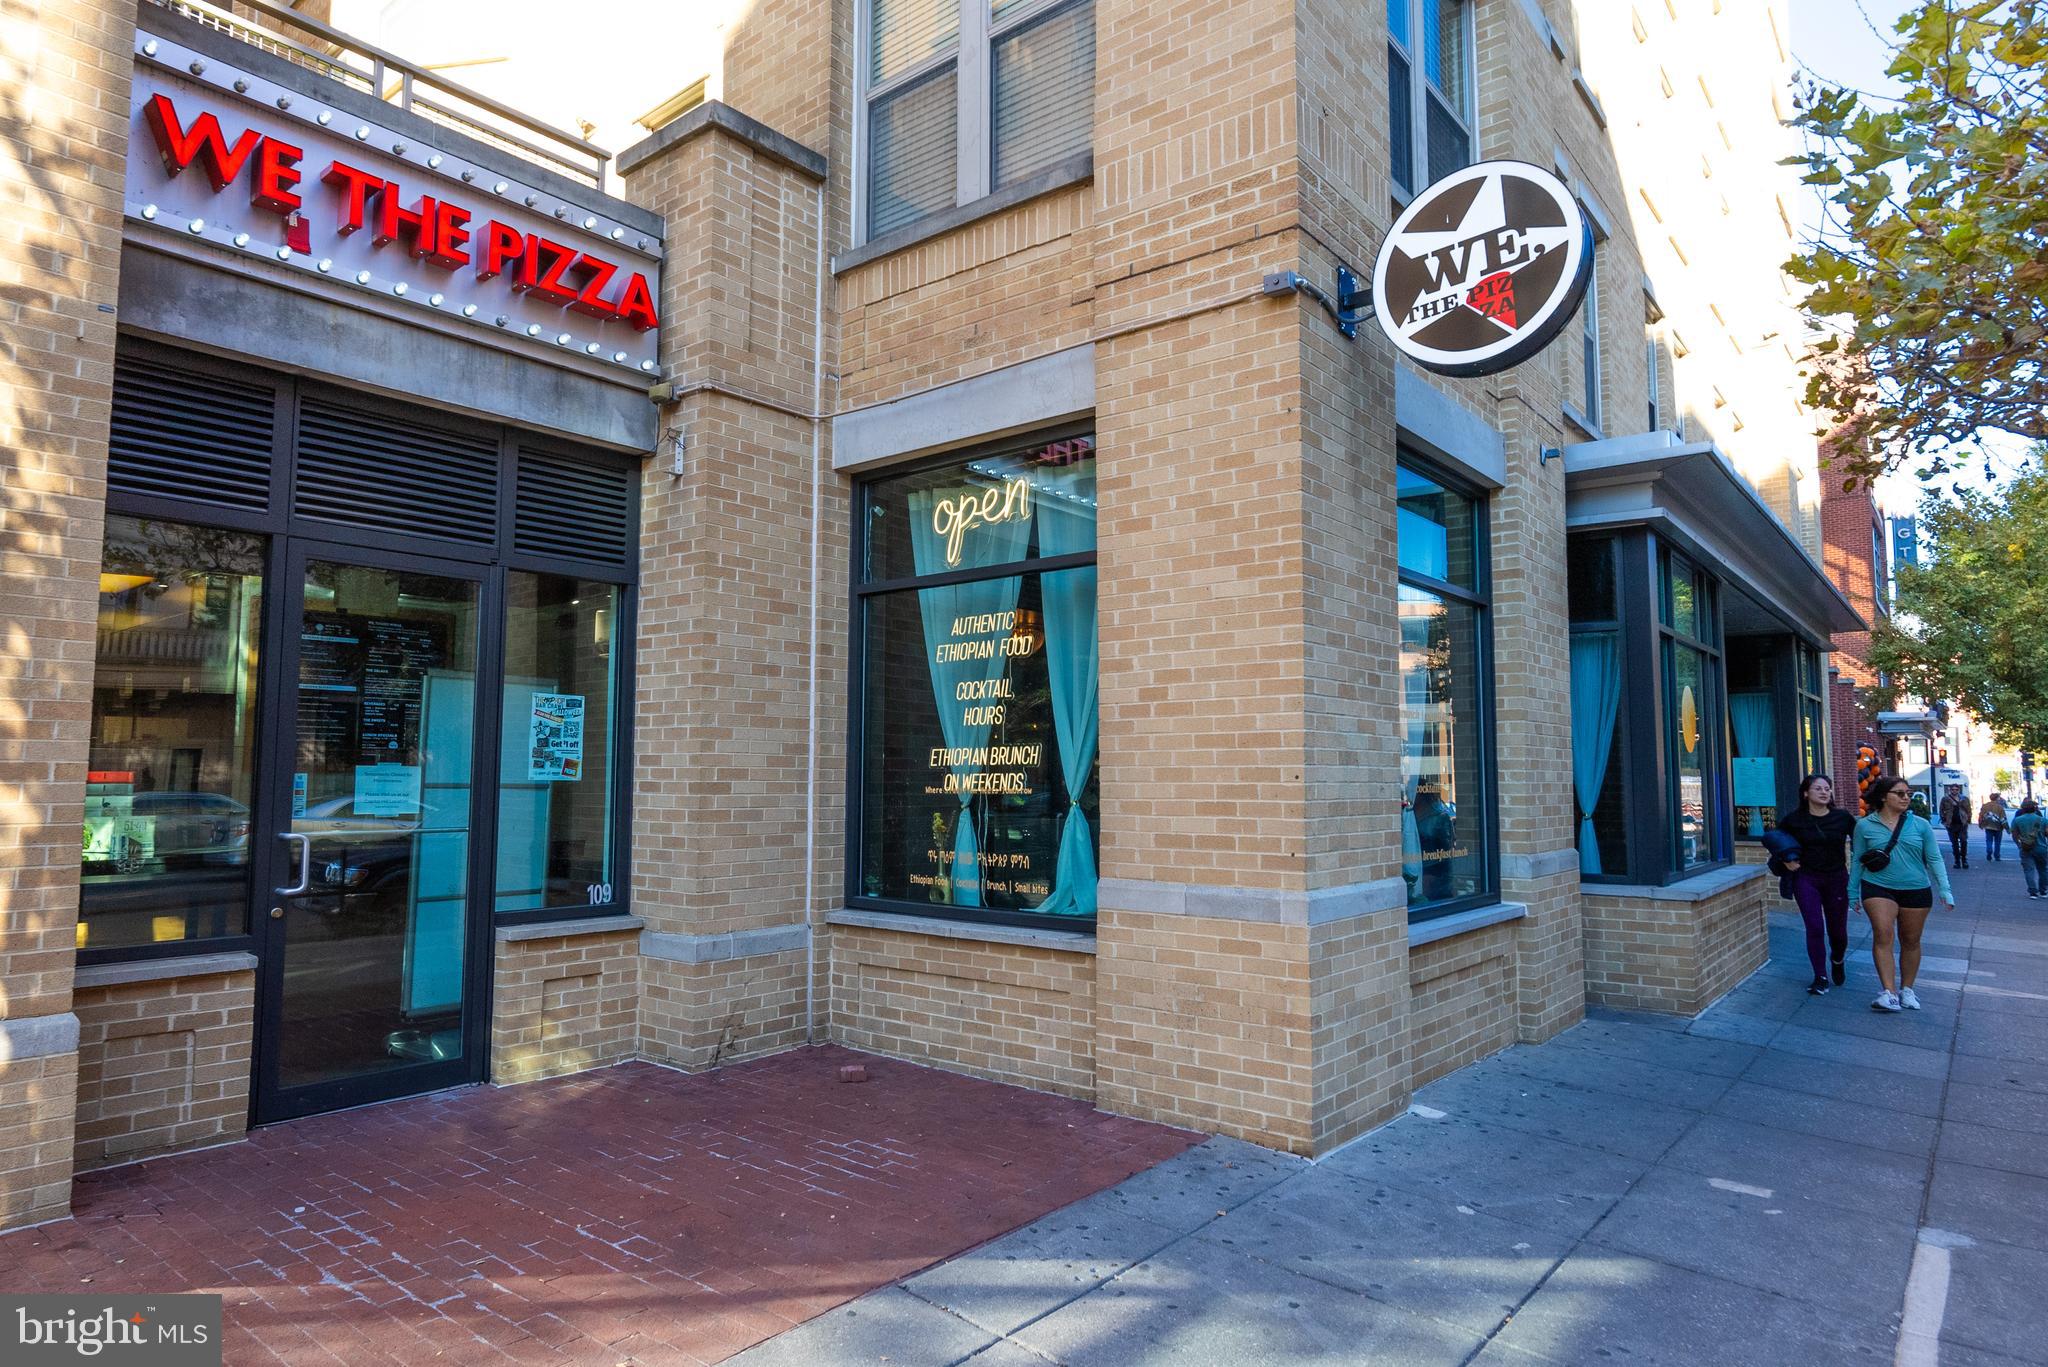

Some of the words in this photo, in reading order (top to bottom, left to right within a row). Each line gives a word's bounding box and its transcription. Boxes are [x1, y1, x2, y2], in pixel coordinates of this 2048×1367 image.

[321, 160, 471, 271] THE
[476, 219, 660, 333] PIZZA
[1407, 293, 1459, 325] THE
[1467, 275, 1514, 304] PIZ
[1479, 296, 1516, 319] ZA
[933, 478, 1029, 564] open
[951, 611, 1016, 637] AUTHENTIC
[936, 639, 995, 664] ETHIOPIAN
[999, 635, 1034, 657] FOOD
[956, 679, 1013, 701] COCKTAIL
[963, 706, 1005, 726] HOURS
[929, 748, 988, 767] ETHIOPIAN
[989, 745, 1041, 766] BRUNCH
[944, 773, 959, 792] ON
[962, 772, 1025, 792] WEEKENDS
[587, 883, 612, 905] 109
[910, 873, 934, 887] Ethiopian
[986, 879, 1007, 891] Brunch
[1014, 882, 1031, 894] Small
[1032, 883, 1049, 895] bites
